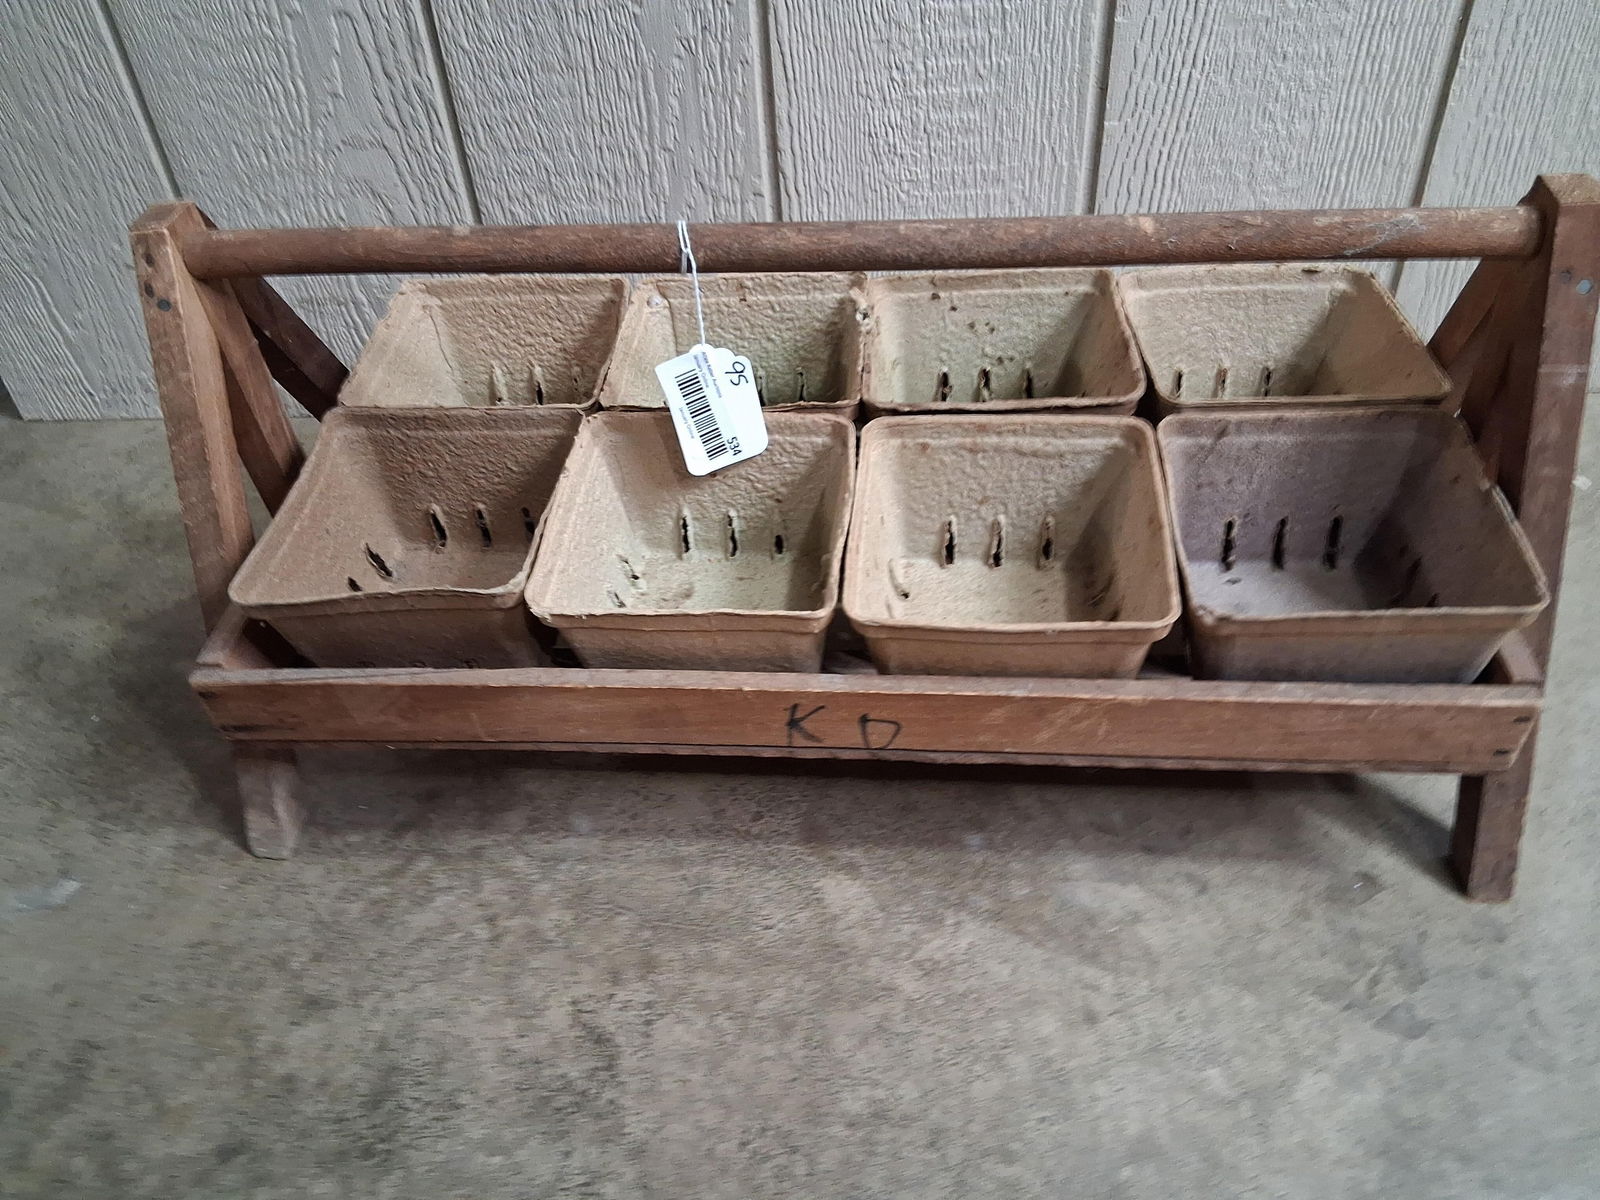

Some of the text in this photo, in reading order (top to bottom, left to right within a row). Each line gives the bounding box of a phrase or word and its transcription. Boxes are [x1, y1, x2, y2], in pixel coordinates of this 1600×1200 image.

[725, 361, 749, 386] 95
[686, 424, 695, 439] Online
[727, 437, 744, 456] 534
[783, 703, 903, 747] K D
